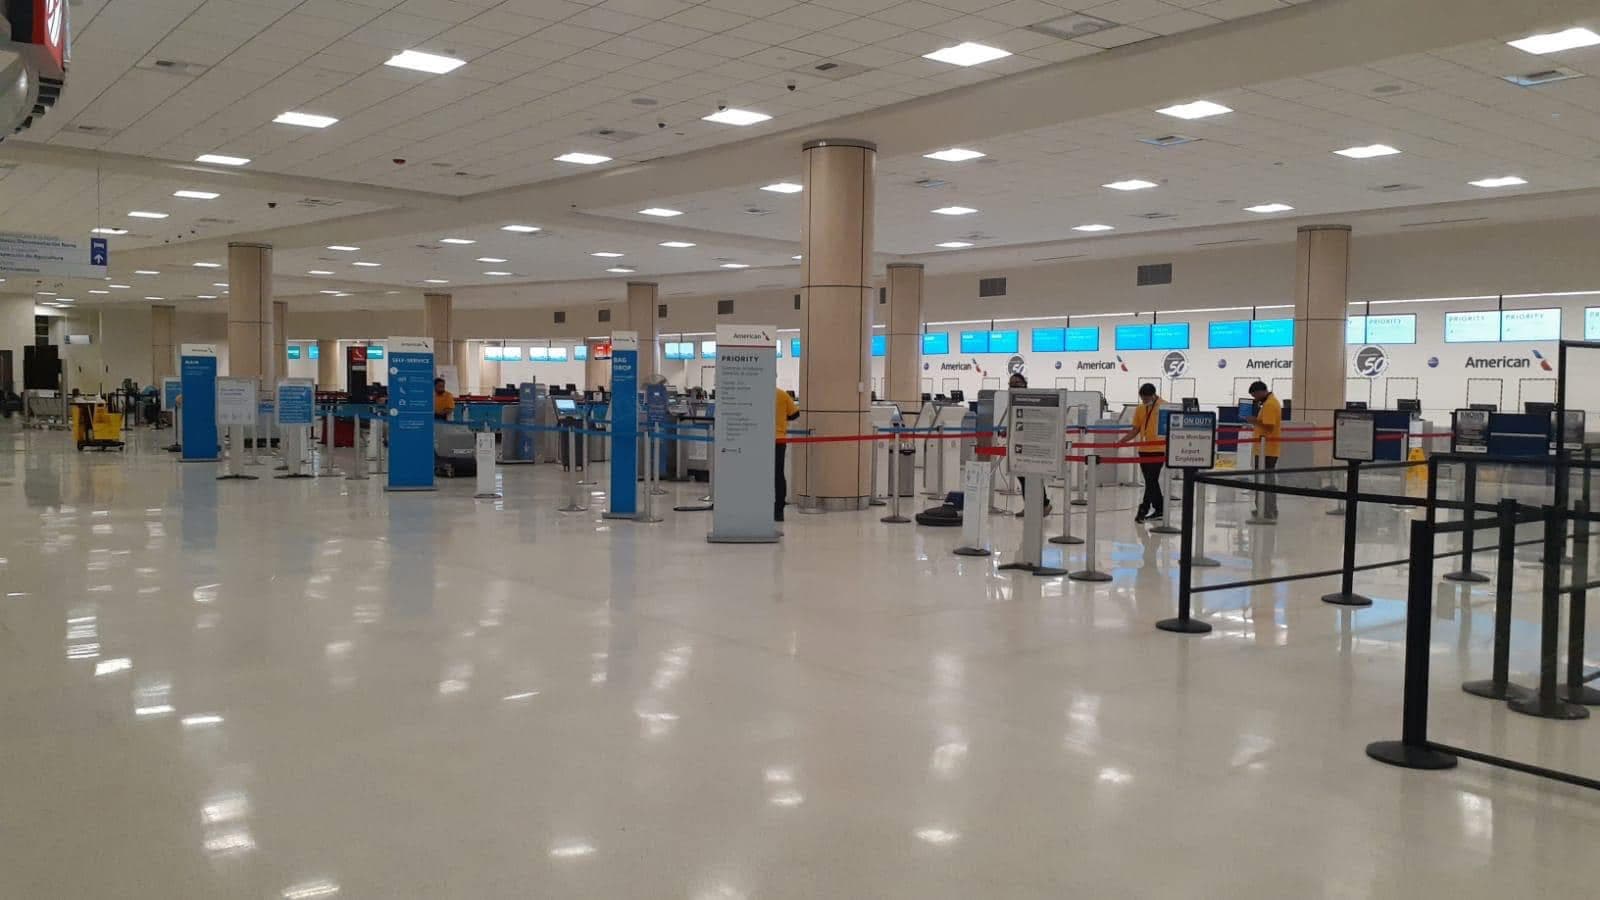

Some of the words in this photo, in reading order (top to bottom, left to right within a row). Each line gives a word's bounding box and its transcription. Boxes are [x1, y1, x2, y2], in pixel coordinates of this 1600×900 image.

[1449, 315, 1485, 323] PRIORITY
[1505, 312, 1544, 320] PRIORITY
[1369, 318, 1401, 326] PRIORITY
[940, 362, 972, 371] American
[1077, 360, 1116, 371] American
[1362, 356, 1385, 375] 50
[1465, 355, 1530, 369] American
